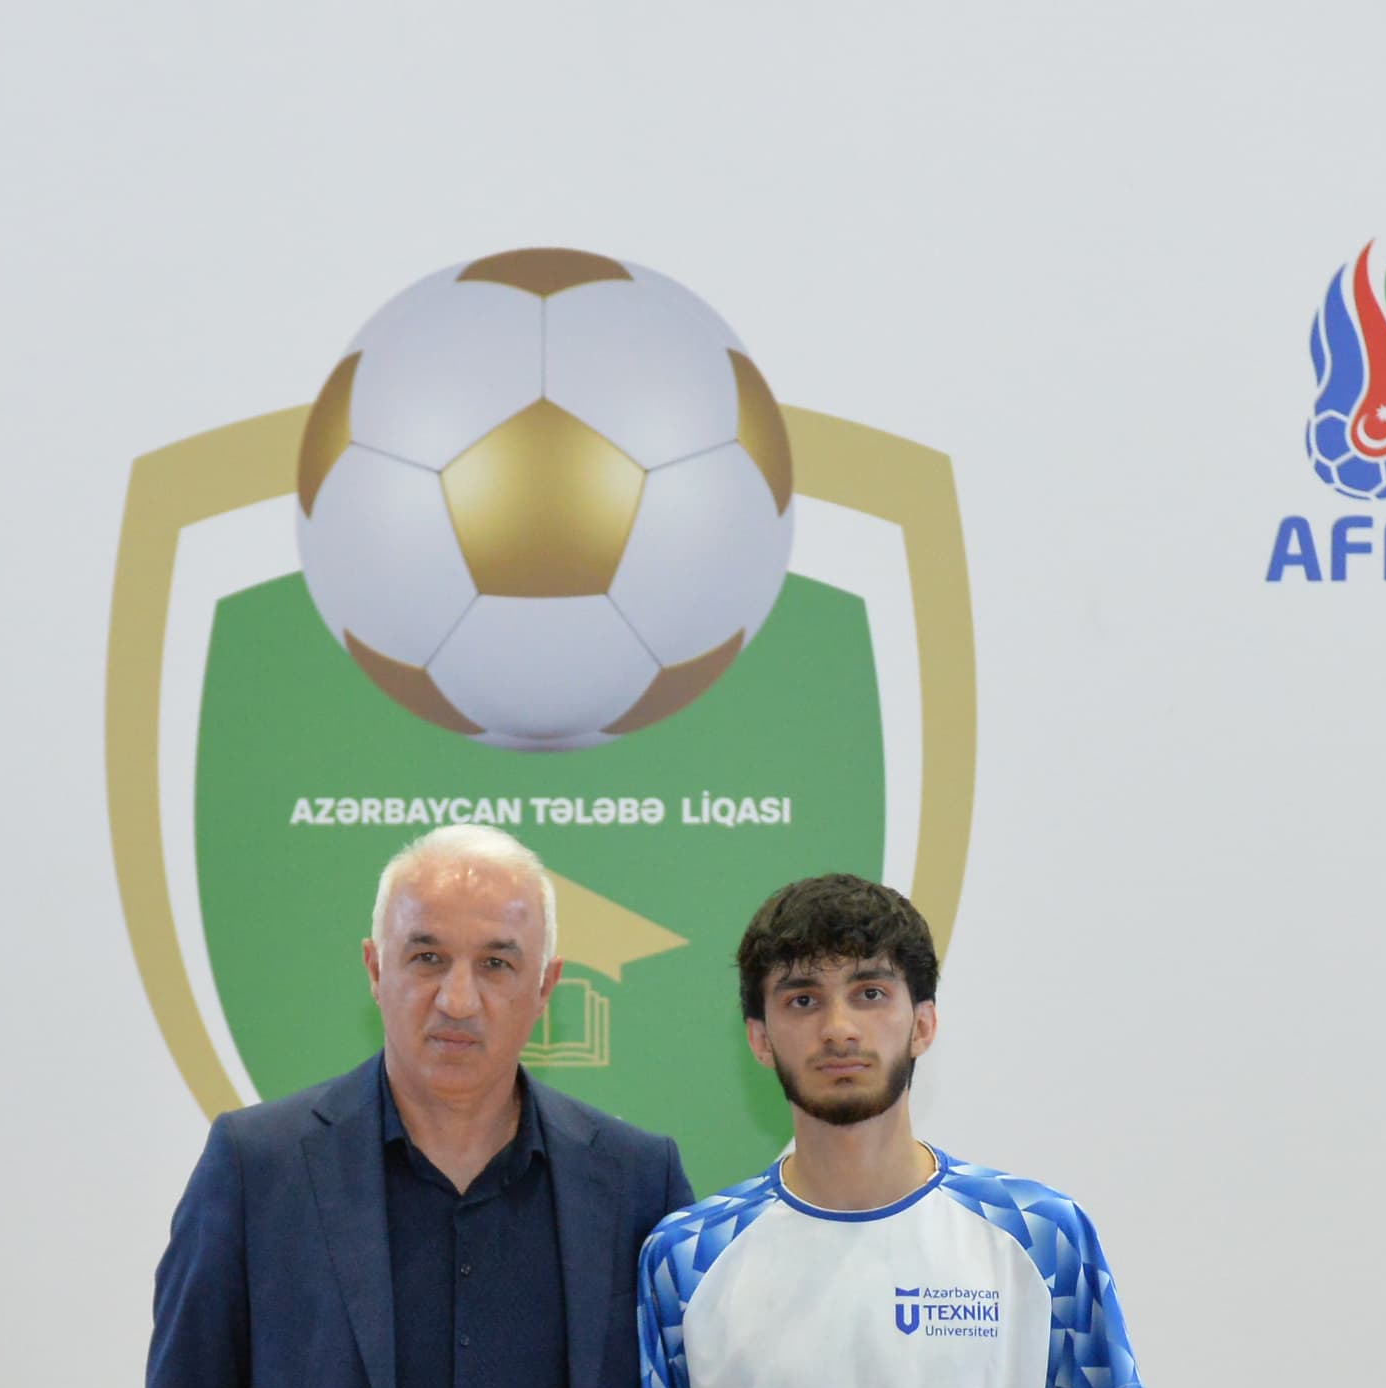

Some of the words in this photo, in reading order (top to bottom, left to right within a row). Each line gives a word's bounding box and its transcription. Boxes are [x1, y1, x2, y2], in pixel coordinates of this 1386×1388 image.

[290, 797, 522, 825] AZƏRBAYCAN
[530, 797, 665, 825] TƏLƏBƏ
[681, 791, 791, 828] LİQASI
[923, 1286, 1000, 1301] Azərbaycan
[923, 1301, 1000, 1322] TEXNİKİ
[924, 1325, 999, 1338] Universiteti
